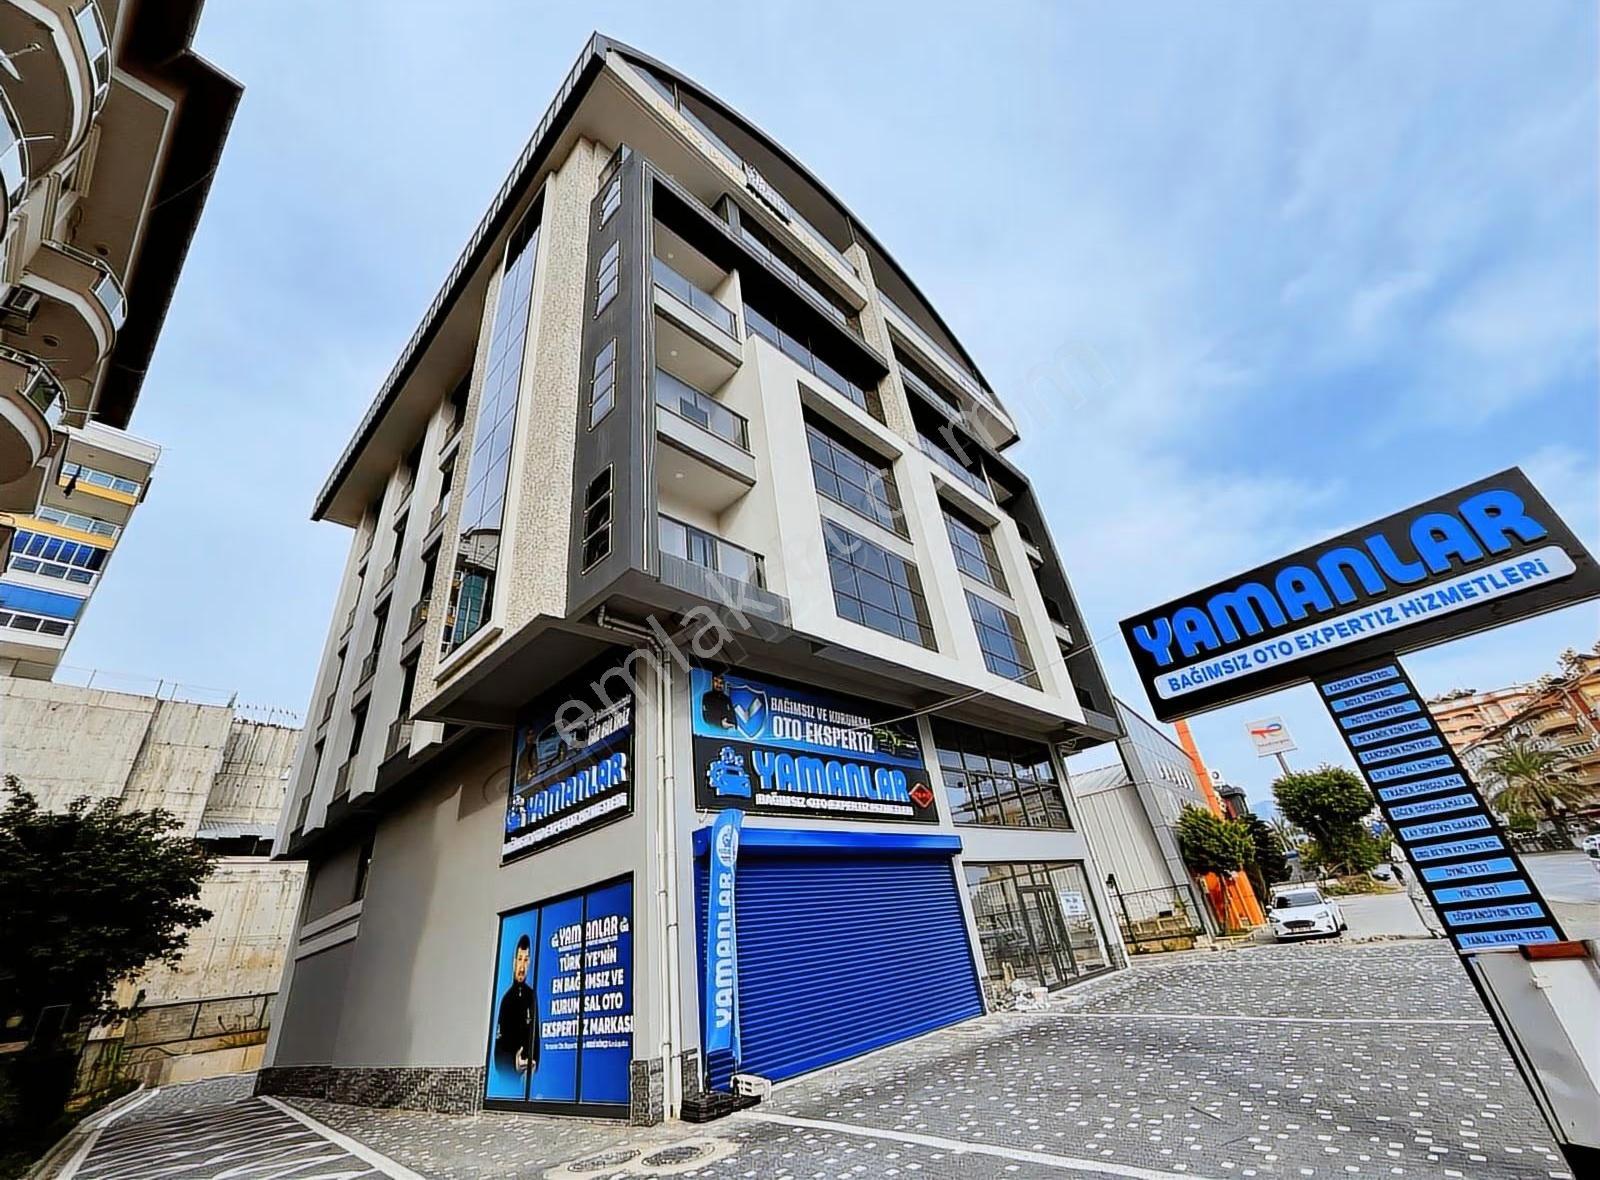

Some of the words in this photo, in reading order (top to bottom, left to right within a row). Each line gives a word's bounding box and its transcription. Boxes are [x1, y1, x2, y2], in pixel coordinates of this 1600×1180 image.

[1133, 488, 1547, 666] YAMANLAR
[1167, 655, 1253, 693] BAĞIMSIZ
[1253, 640, 1294, 665] OTO
[1298, 606, 1399, 651] EXPERTIZ
[1402, 558, 1549, 616] HİZMETLERİ
[771, 697, 815, 719] BAĞIMSIZ
[817, 707, 828, 721] VE
[773, 715, 802, 741] OTO
[805, 721, 875, 753] EKSPERTİZ
[527, 752, 628, 824] YAMANLAR
[752, 750, 911, 802] YAMANLAR
[559, 915, 619, 946] YAMANLAR
[1523, 929, 1548, 941] TEST
[714, 872, 733, 1028] YAMANLAR
[552, 978, 563, 994] EN
[564, 971, 610, 993] BAĞIMSIZ
[611, 968, 624, 986] VE
[551, 994, 600, 1016] KURUMSAL
[602, 992, 624, 1010] OTO
[541, 1014, 589, 1038] EKSPERTİZ
[590, 1014, 634, 1036] MARKASI
